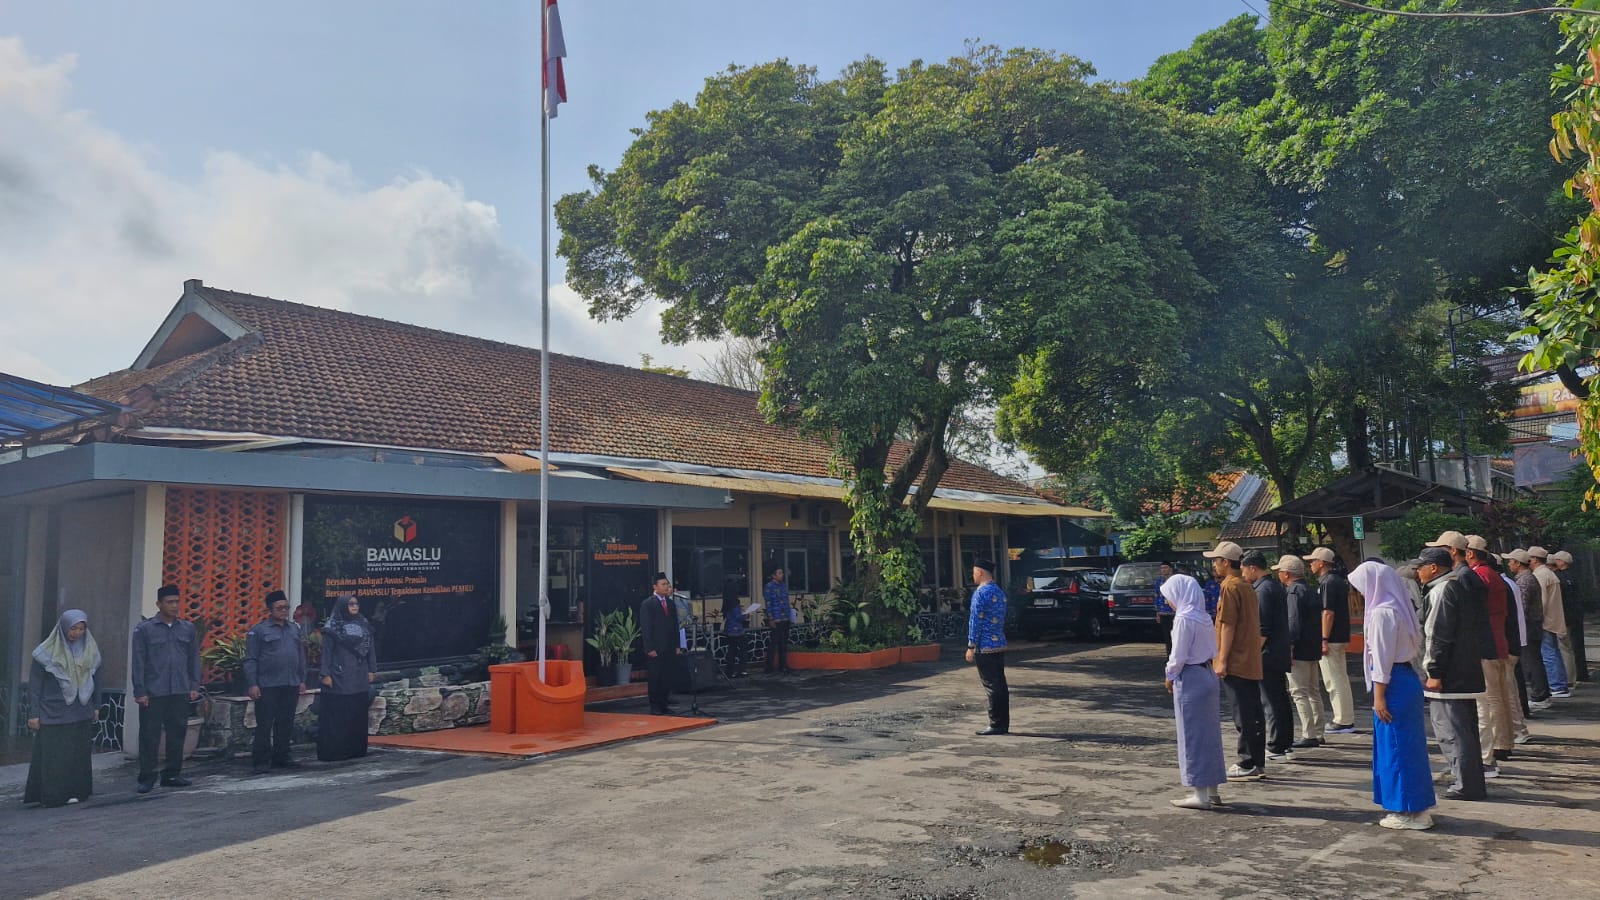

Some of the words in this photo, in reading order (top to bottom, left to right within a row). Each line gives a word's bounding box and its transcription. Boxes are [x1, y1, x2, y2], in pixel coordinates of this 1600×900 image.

[367, 547, 441, 561] BAWASLU
[326, 578, 356, 586] Bersama
[358, 577, 383, 587] Rakyat
[358, 588, 390, 597] BAWASLU
[452, 584, 474, 593] PEMILU
